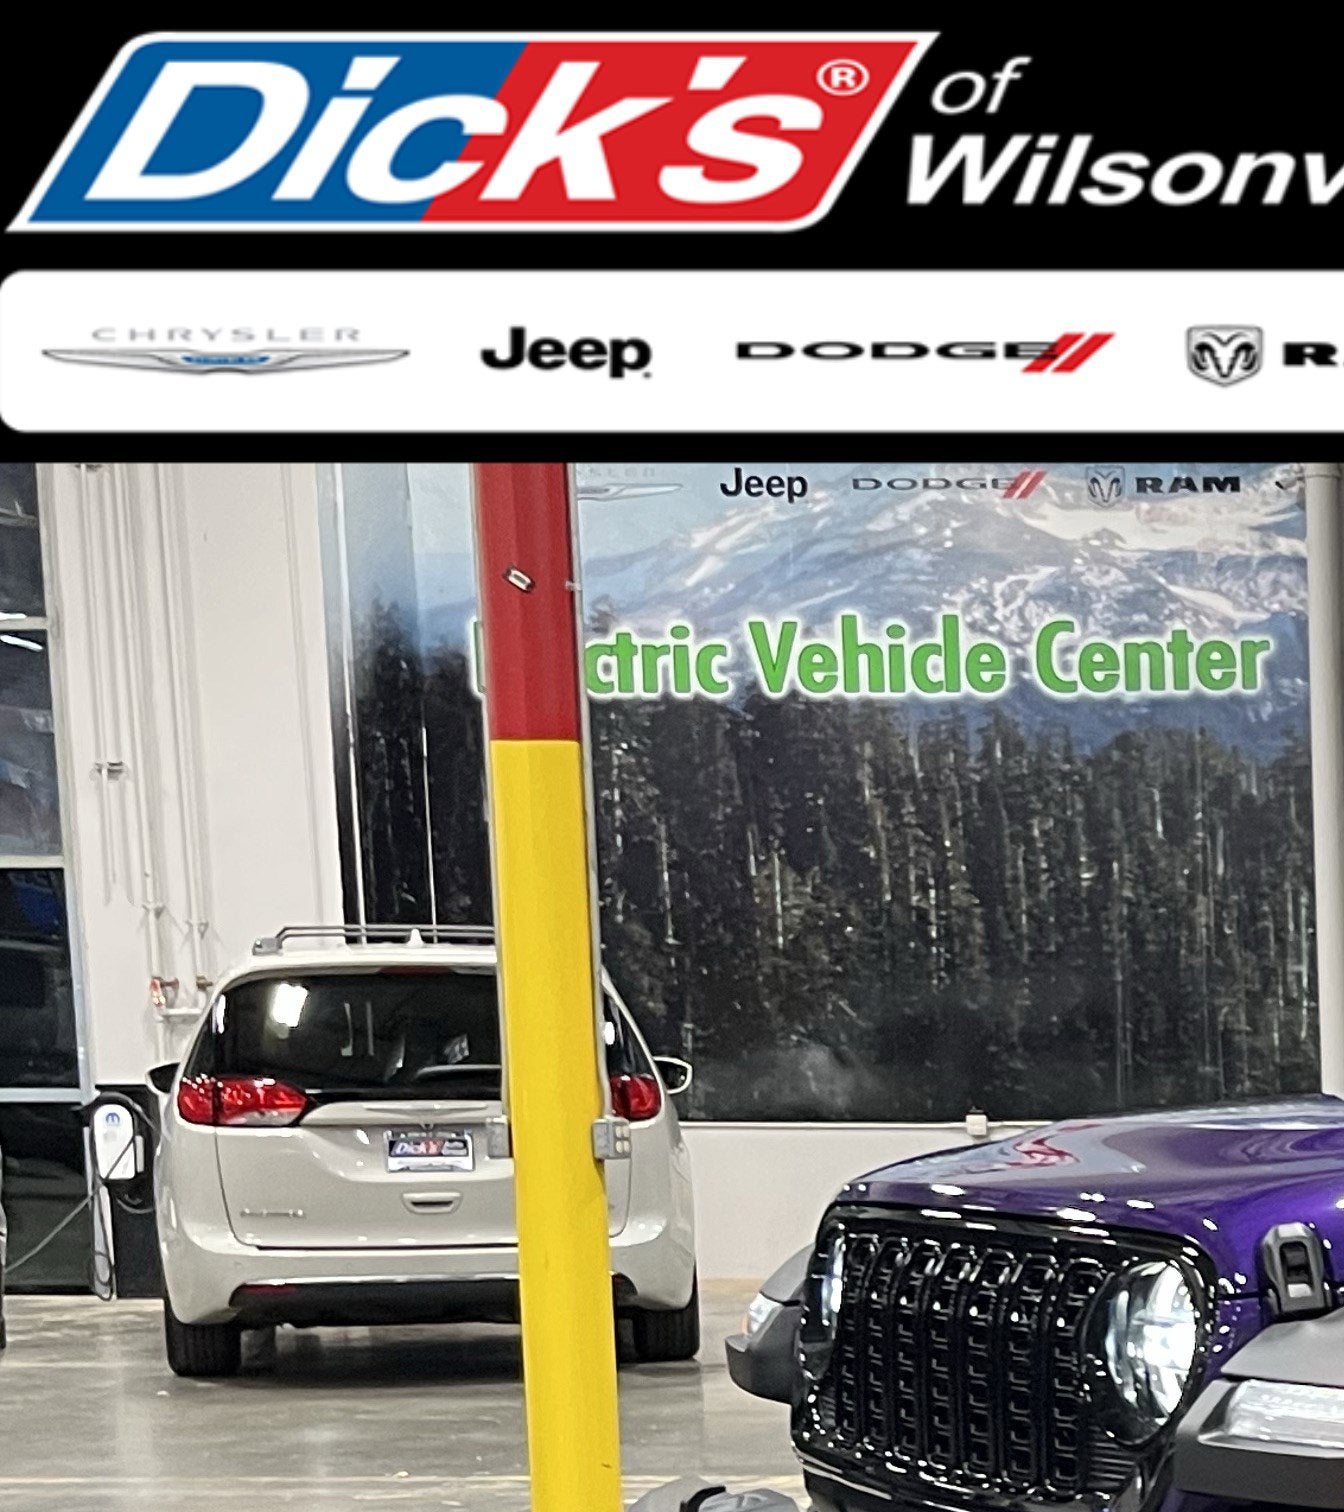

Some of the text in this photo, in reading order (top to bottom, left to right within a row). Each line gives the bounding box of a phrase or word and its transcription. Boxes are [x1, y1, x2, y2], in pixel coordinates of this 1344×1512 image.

[719, 466, 809, 504] Jeep
[851, 477, 1014, 492] DODGE
[1135, 476, 1241, 494] RAM
[750, 614, 1007, 695] Vehicle
[1035, 620, 1270, 694] Center
